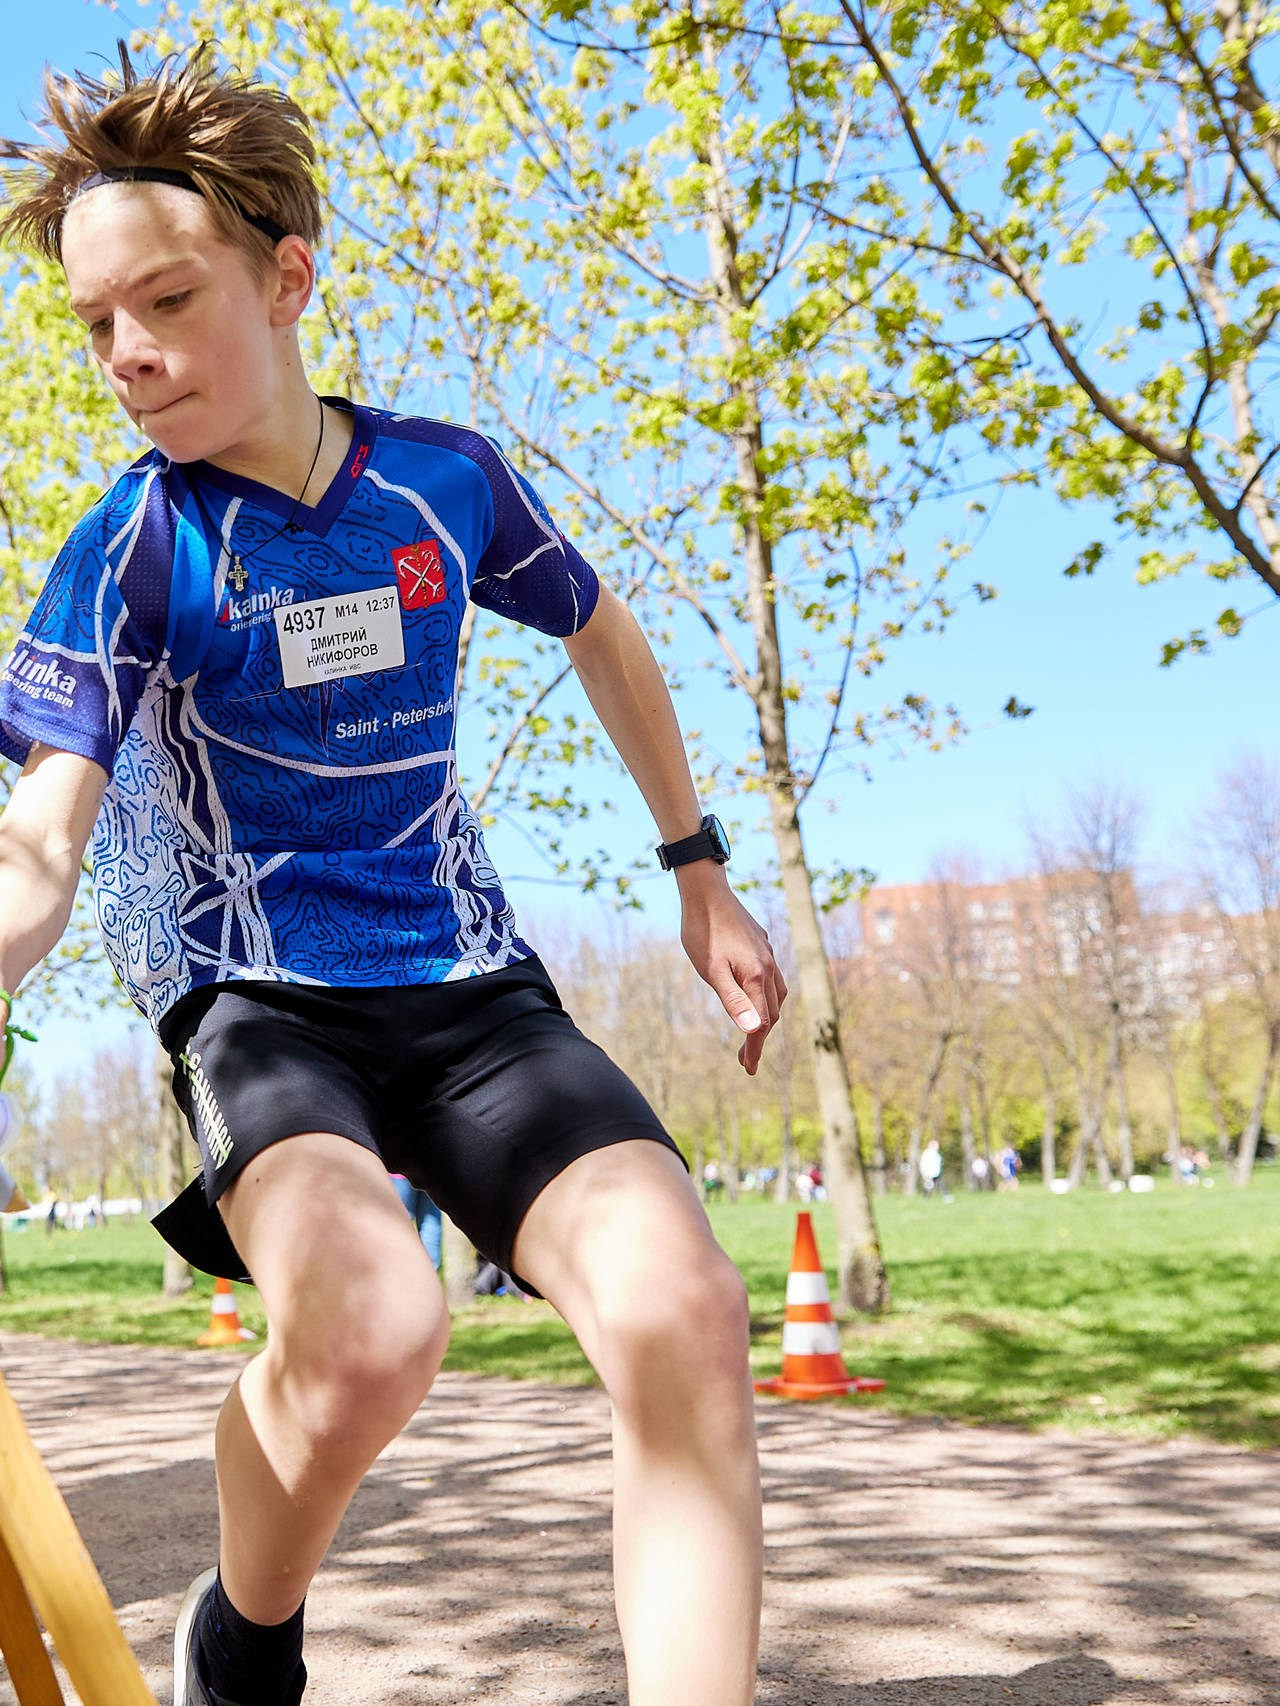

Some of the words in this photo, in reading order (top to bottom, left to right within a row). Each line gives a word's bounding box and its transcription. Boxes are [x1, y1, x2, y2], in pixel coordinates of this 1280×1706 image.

[283, 606, 326, 635] 4937
[366, 597, 395, 612] 12:37
[311, 627, 367, 652] ДМИТРИЙ
[307, 643, 379, 668] НИКИФОРОВ
[42, 687, 74, 708] team
[335, 717, 380, 739] Saint
